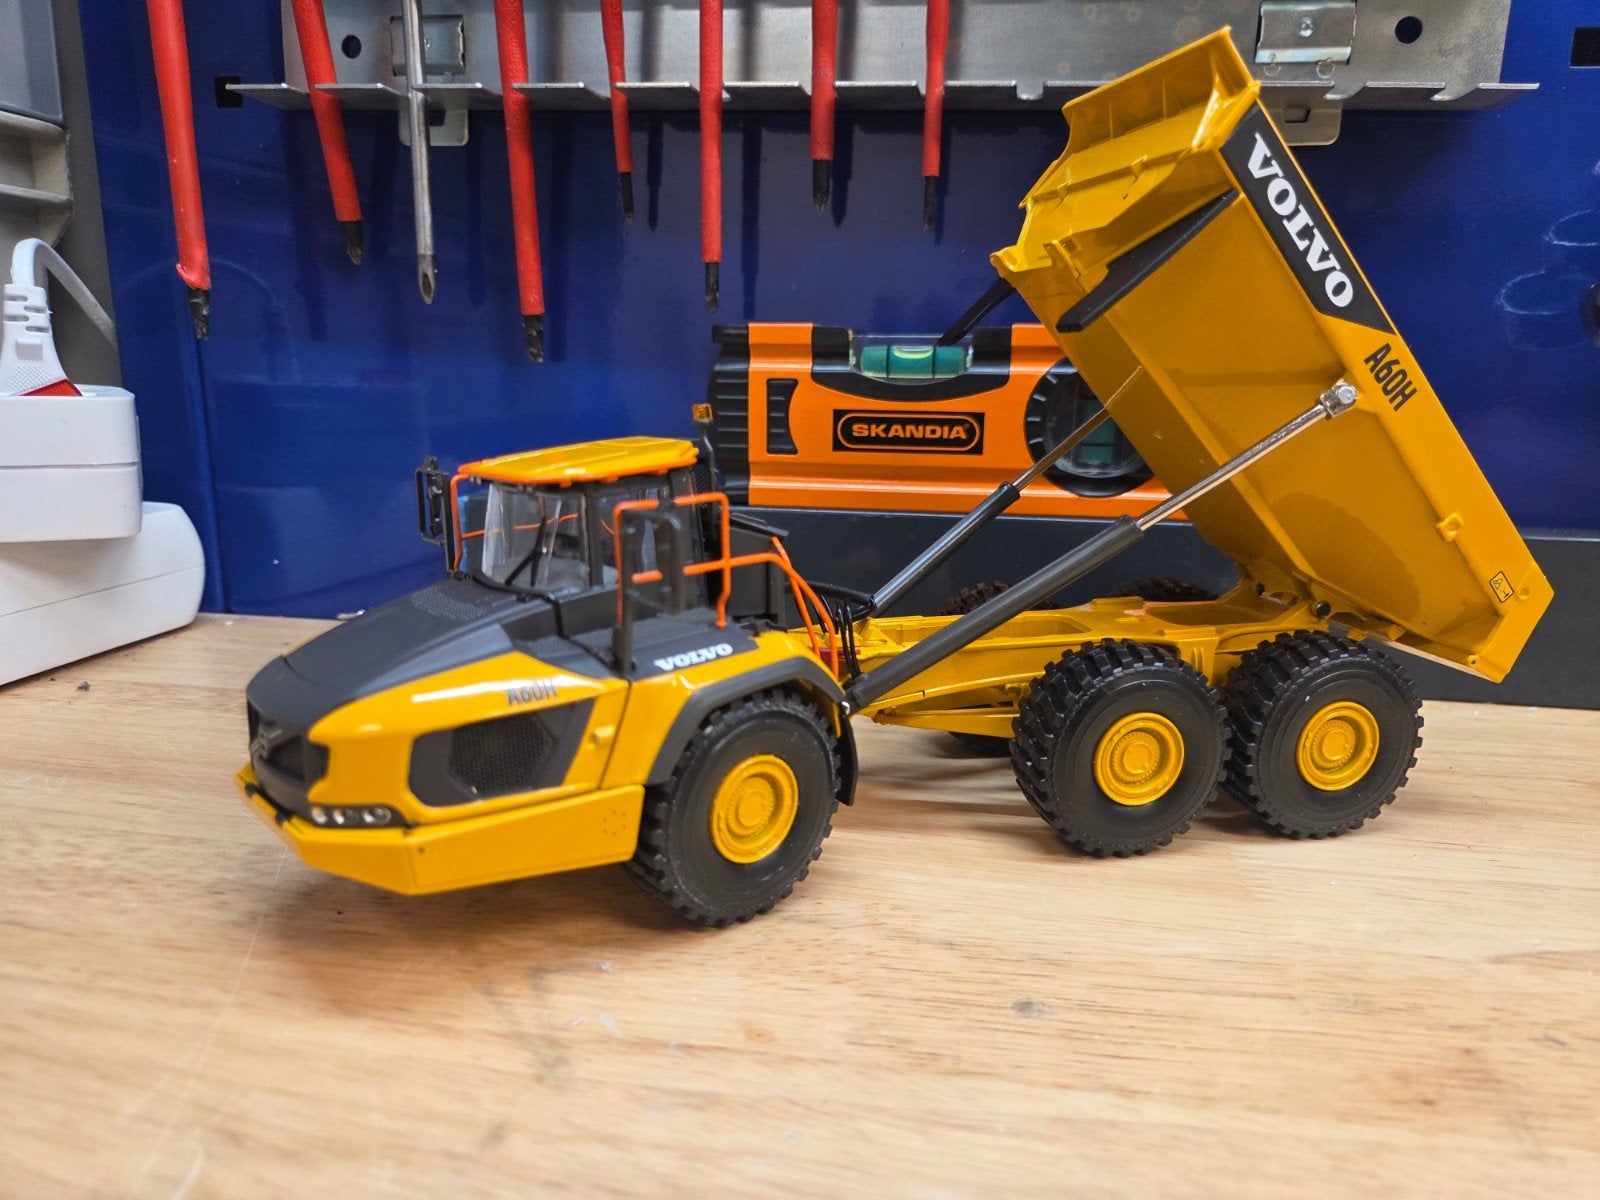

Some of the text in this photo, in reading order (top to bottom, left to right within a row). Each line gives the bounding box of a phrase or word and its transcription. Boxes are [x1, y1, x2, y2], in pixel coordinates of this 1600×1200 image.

[1247, 132, 1354, 308] VOLVO
[1363, 343, 1418, 411] A60H
[851, 423, 968, 440] SKANDIA
[653, 643, 734, 671] VOLVO
[506, 679, 559, 706] A60H
